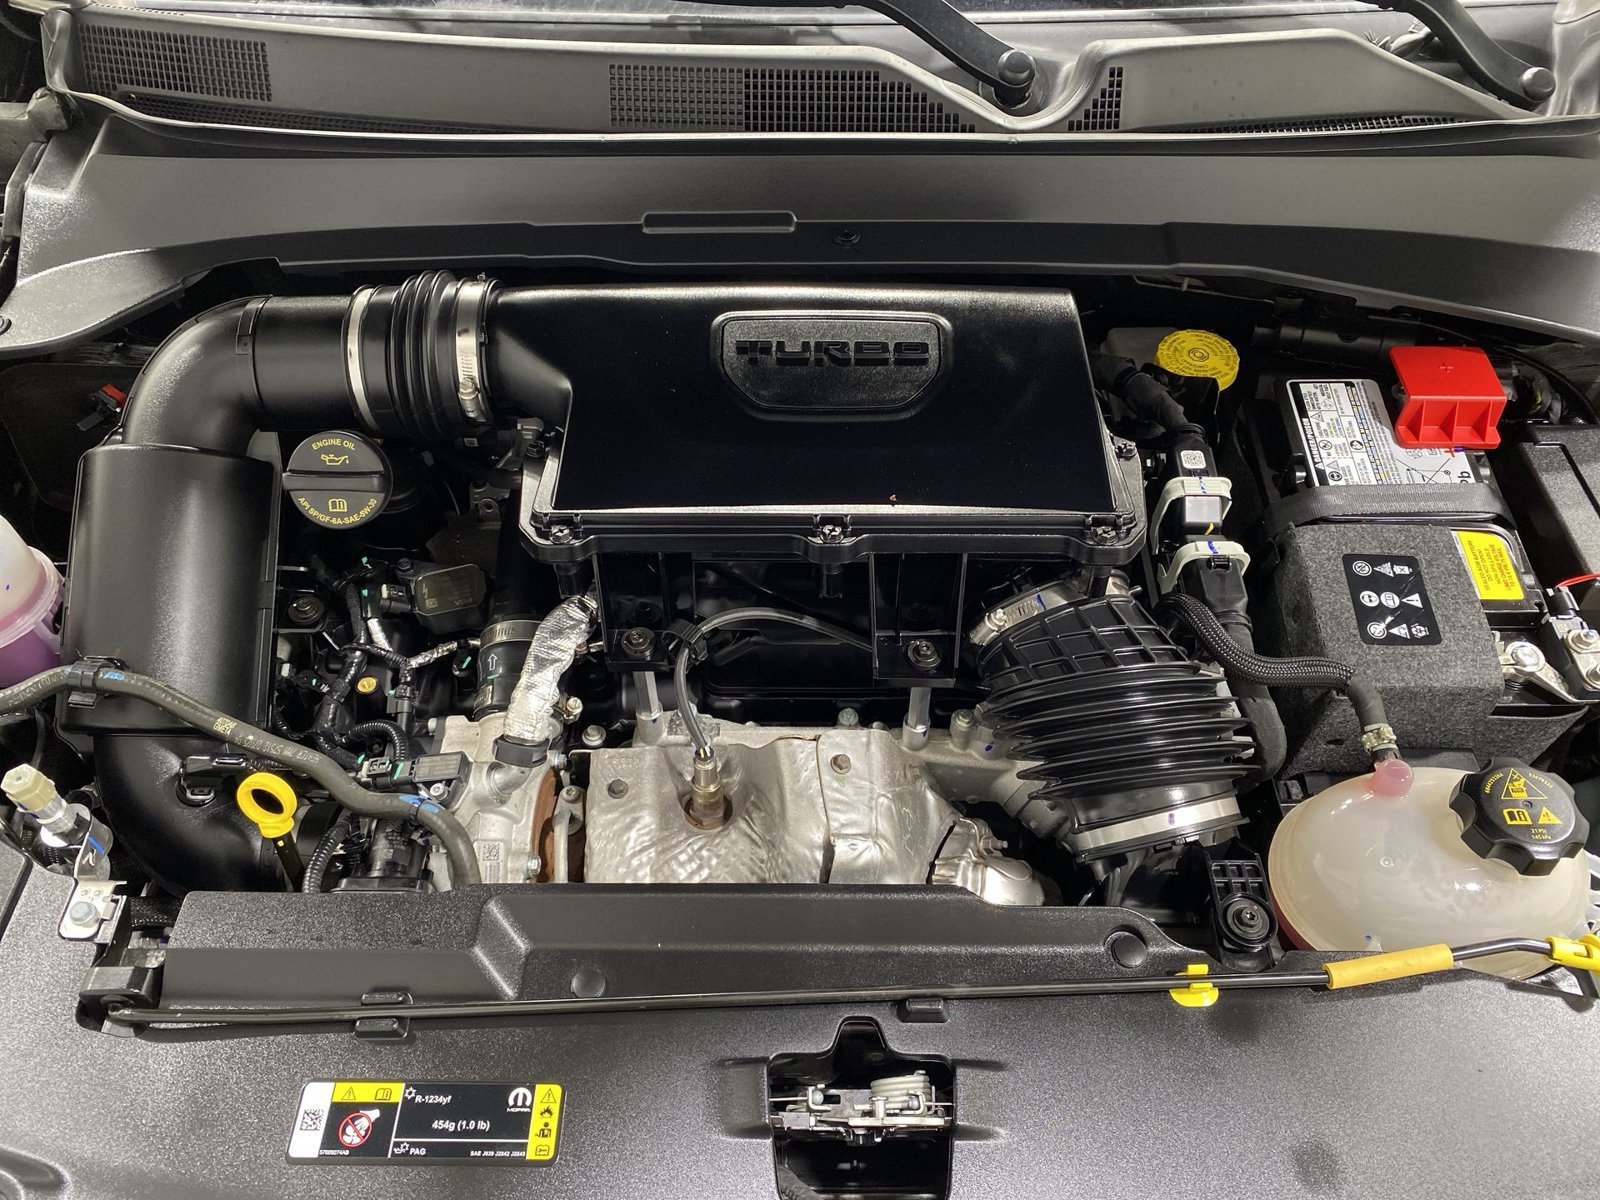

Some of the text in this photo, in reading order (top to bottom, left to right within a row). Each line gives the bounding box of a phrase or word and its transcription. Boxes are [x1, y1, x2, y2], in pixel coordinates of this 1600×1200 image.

[735, 340, 929, 366] TURBO
[311, 438, 356, 451] ENGINE OIL
[298, 497, 311, 510] API
[415, 1095, 452, 1106] R-1234yf
[432, 1120, 491, 1132] 454g (1.0 lb)
[409, 1147, 426, 1156] PAG
